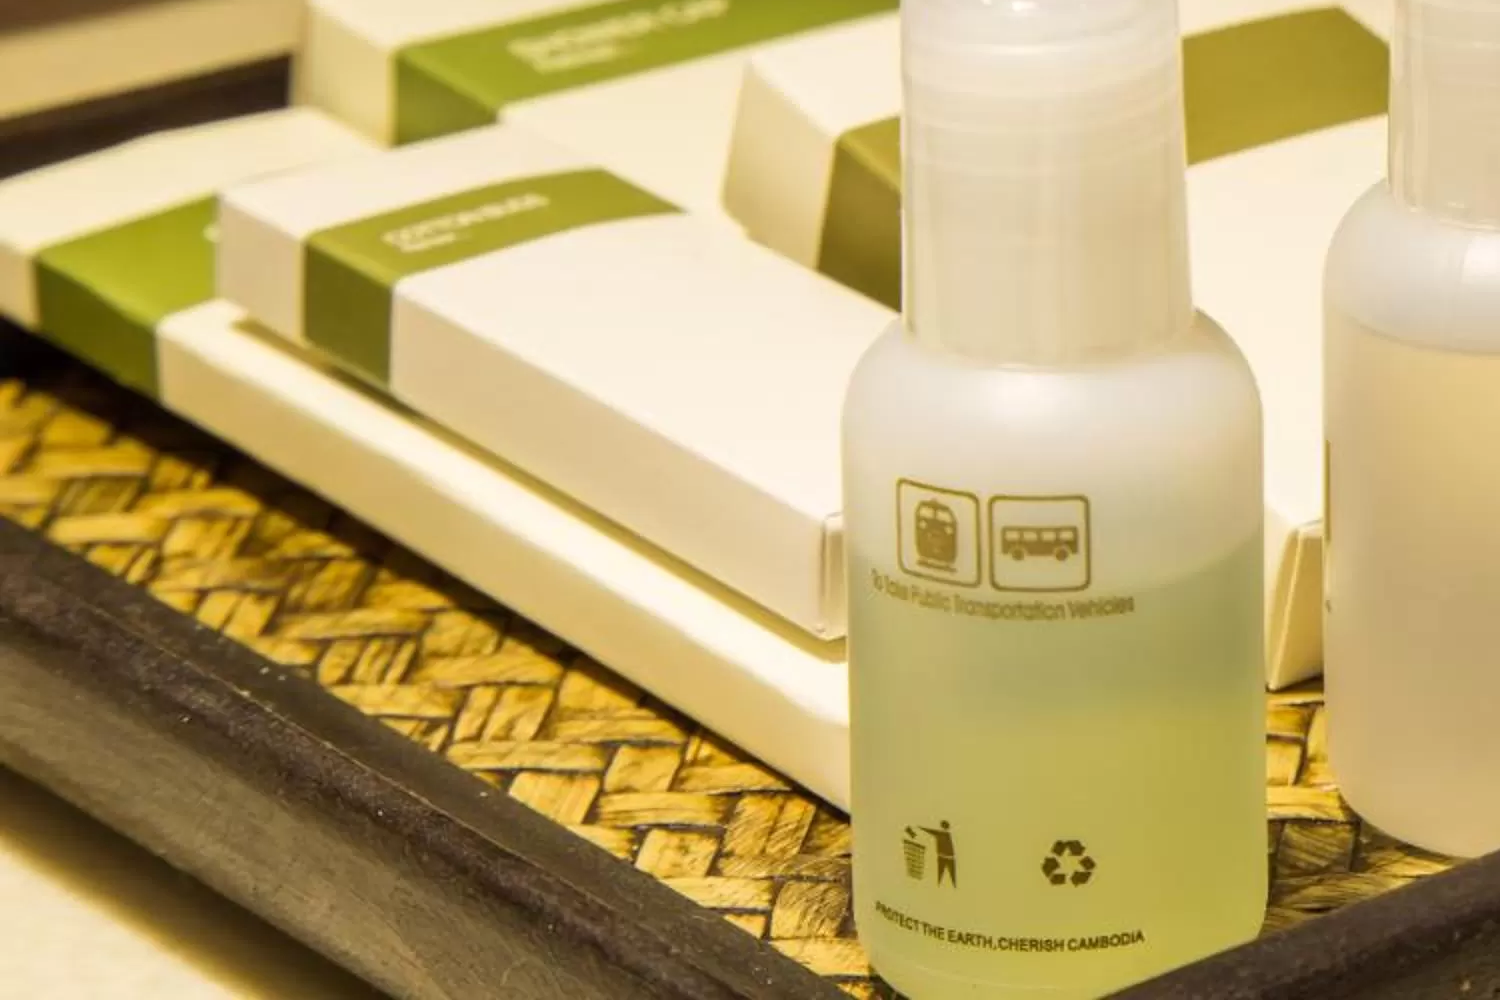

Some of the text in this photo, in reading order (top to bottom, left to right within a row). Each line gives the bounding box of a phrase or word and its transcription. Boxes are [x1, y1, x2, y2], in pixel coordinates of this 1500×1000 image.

[910, 586, 952, 612] Public
[953, 594, 1066, 621] Transportation
[1066, 595, 1137, 619] Vehicles
[875, 900, 920, 932] PROTECT
[921, 921, 945, 941] THE
[1067, 928, 1146, 952] CAMBODIA
